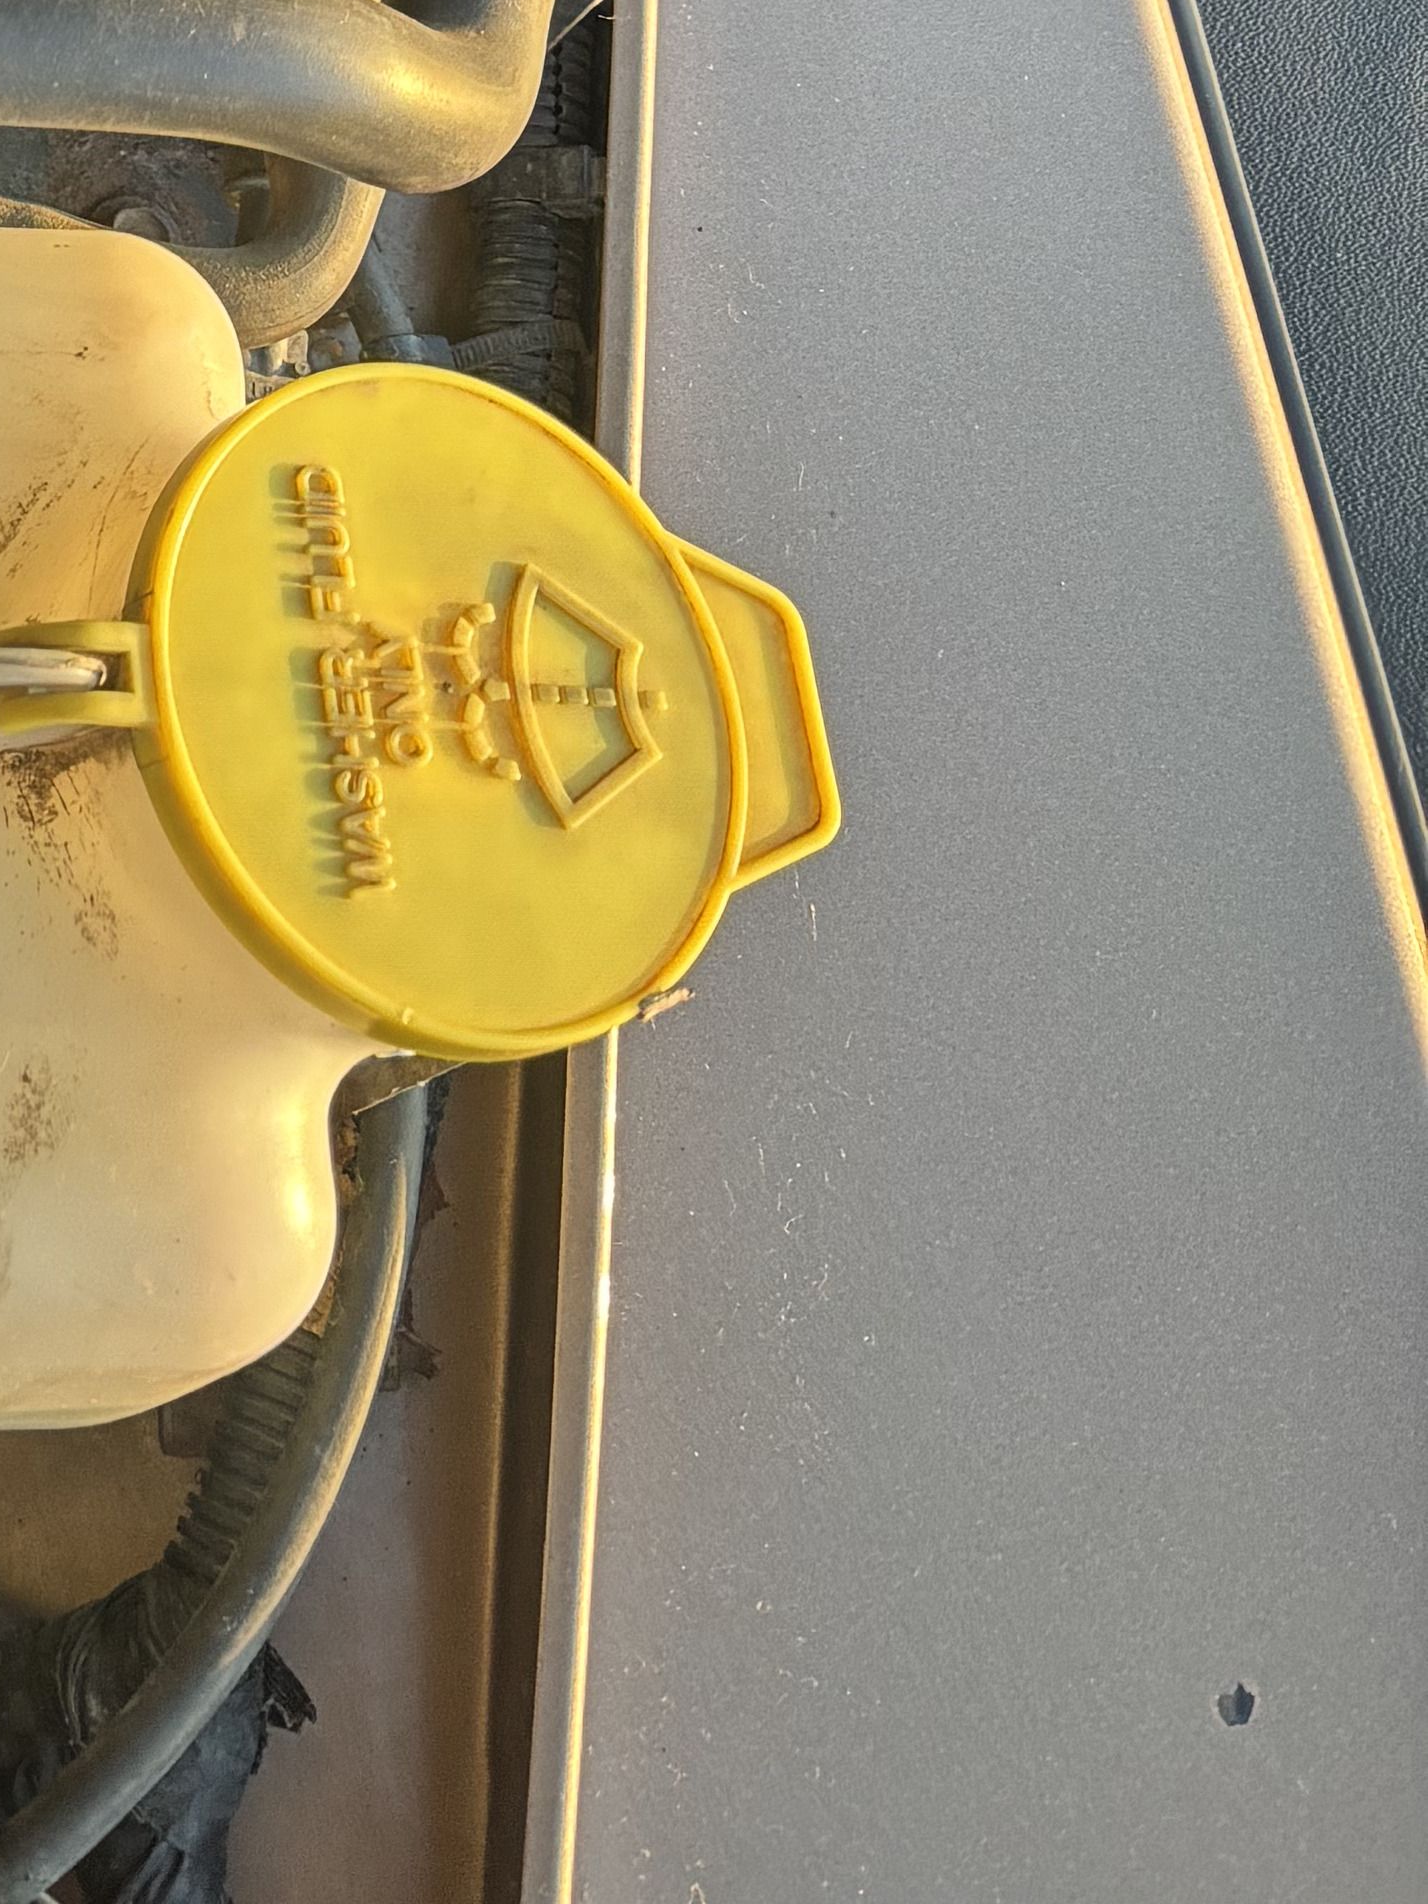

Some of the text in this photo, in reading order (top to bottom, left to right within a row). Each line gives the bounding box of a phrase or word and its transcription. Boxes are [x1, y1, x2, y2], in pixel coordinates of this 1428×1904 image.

[296, 463, 397, 899] WASHER FLUID
[366, 620, 434, 769] ONLY
